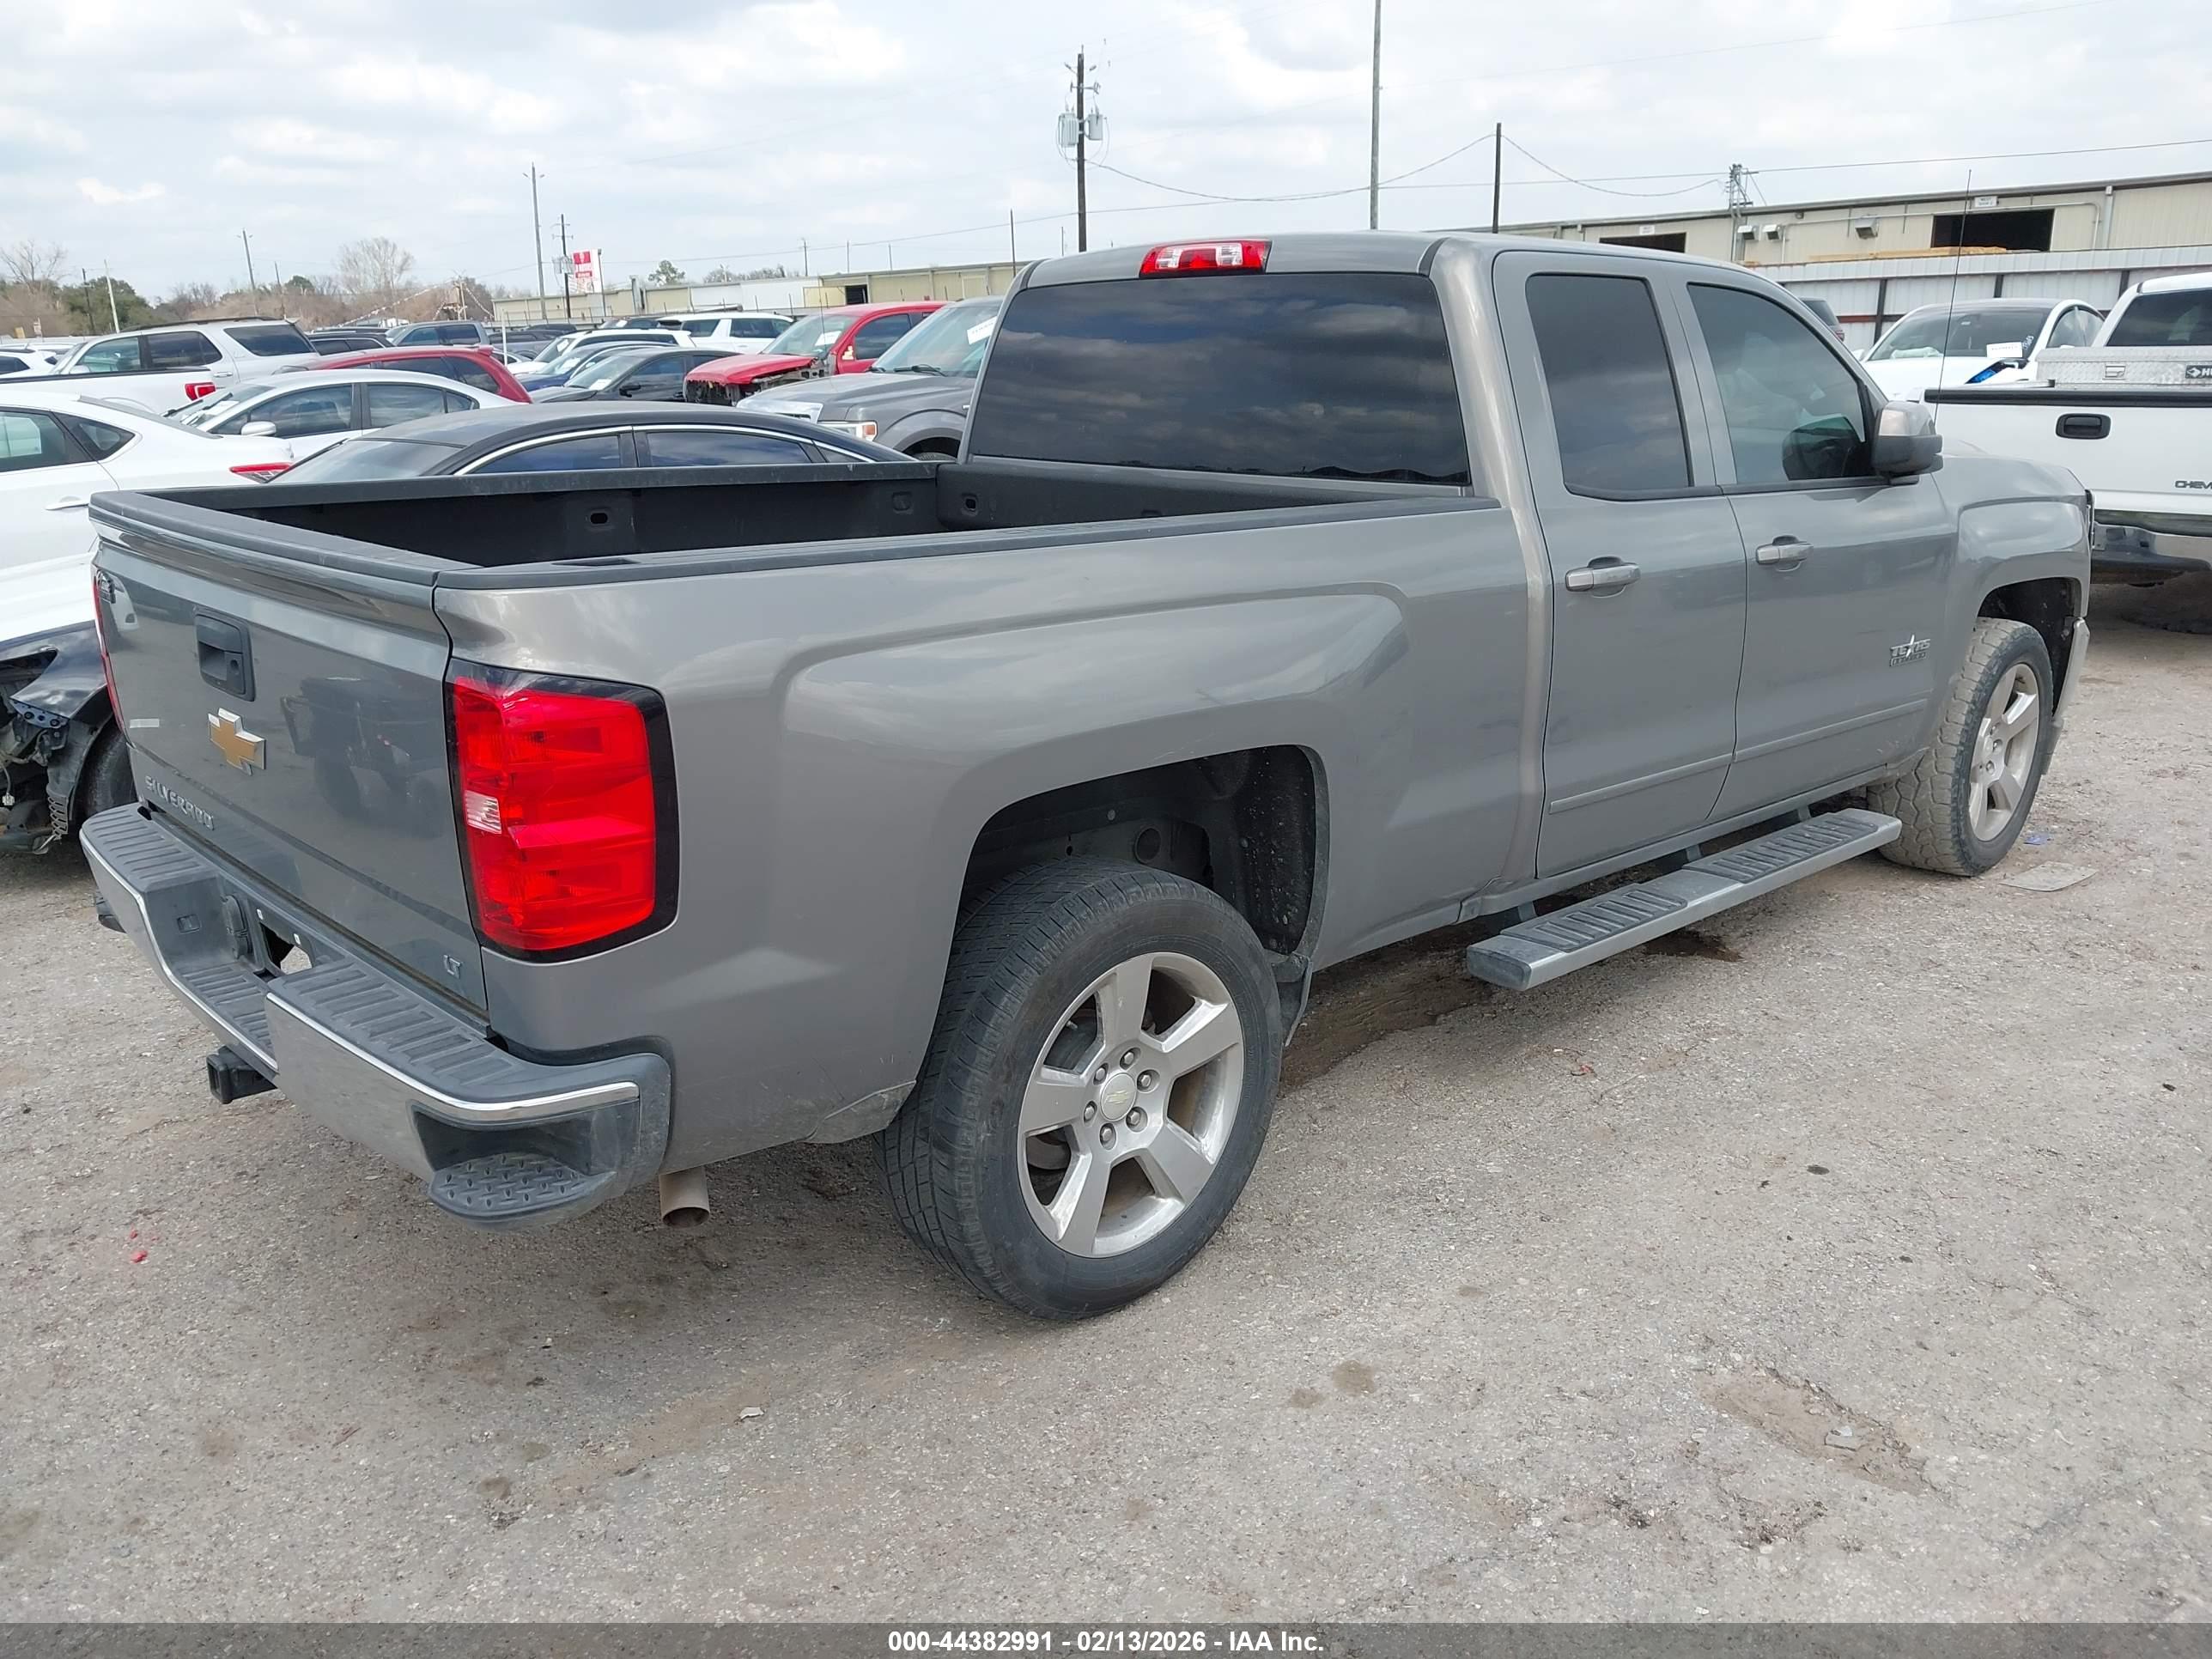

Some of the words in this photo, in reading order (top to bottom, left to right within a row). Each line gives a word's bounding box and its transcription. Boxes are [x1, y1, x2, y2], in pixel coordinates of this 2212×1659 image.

[2175, 480, 2212, 489] CHEV
[144, 775, 215, 831] SILVERADO
[443, 954, 461, 979] LT
